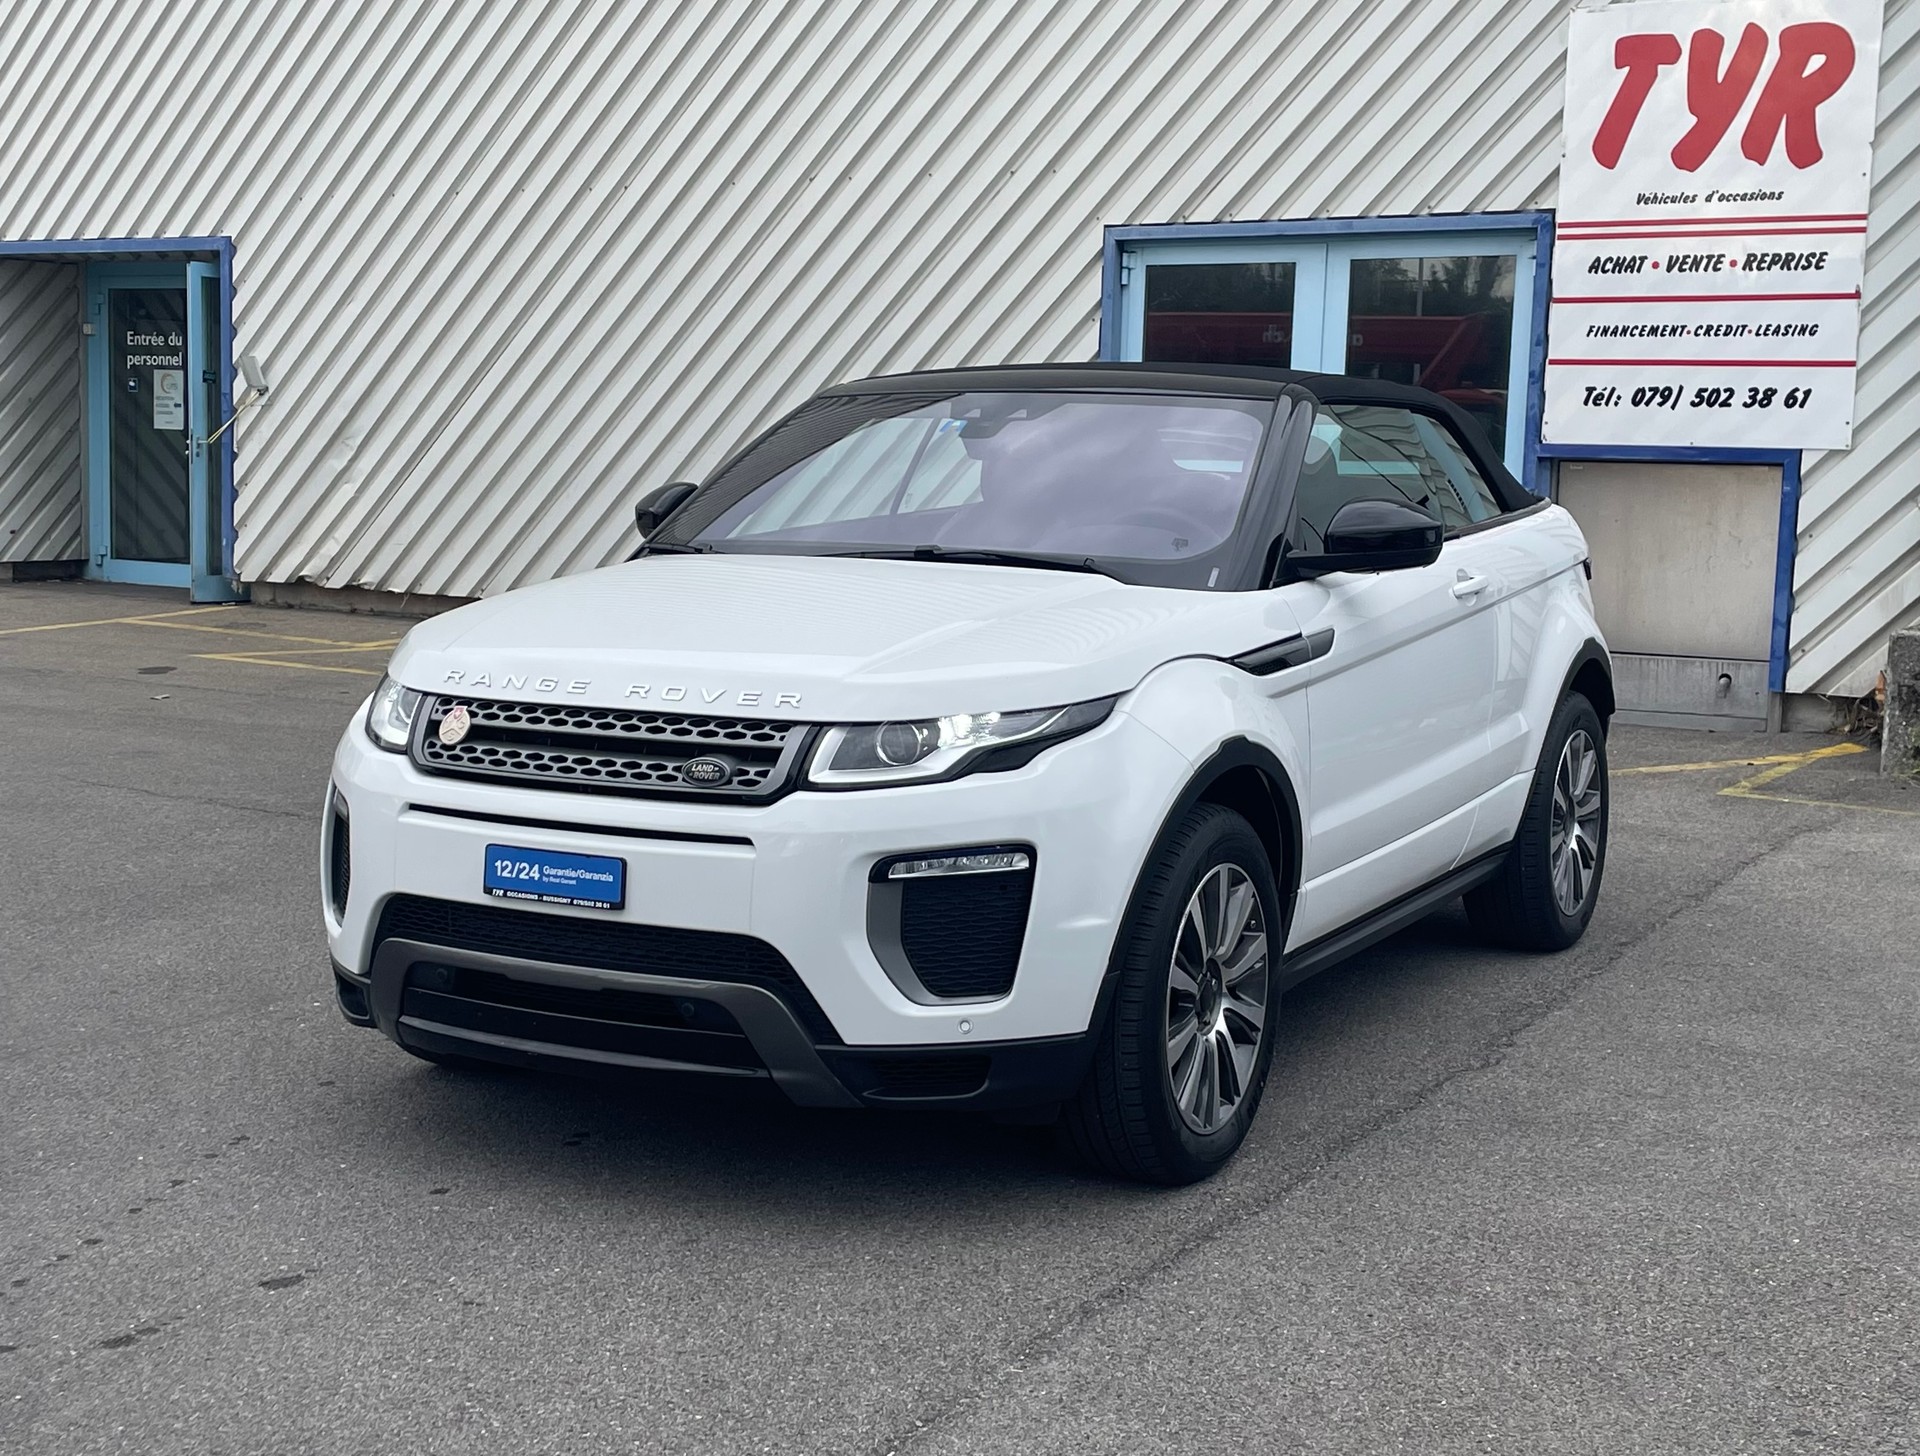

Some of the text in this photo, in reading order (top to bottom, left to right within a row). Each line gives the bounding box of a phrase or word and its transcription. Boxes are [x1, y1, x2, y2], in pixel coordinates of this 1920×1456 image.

[1592, 22, 1857, 173] TYR
[1635, 188, 1785, 206] Véhicules d'occasions
[1587, 251, 1829, 275] ACHAT VENTE REPRISE
[127, 331, 183, 346] Entrée du
[1586, 323, 1819, 338] FINANCEMENT CREDIT LEASING
[127, 352, 183, 369] personnel
[1583, 386, 1622, 408] Tél:
[1690, 387, 1733, 409] 502
[1742, 387, 1778, 409] 38
[1783, 387, 1812, 410] 61
[442, 669, 803, 708] RANGE ROVER
[693, 772, 720, 780] ROVER
[494, 859, 613, 882] 12/24 Garantie/Garanzia
[492, 888, 504, 897] TYR
[507, 891, 538, 900] OCCASIONS
